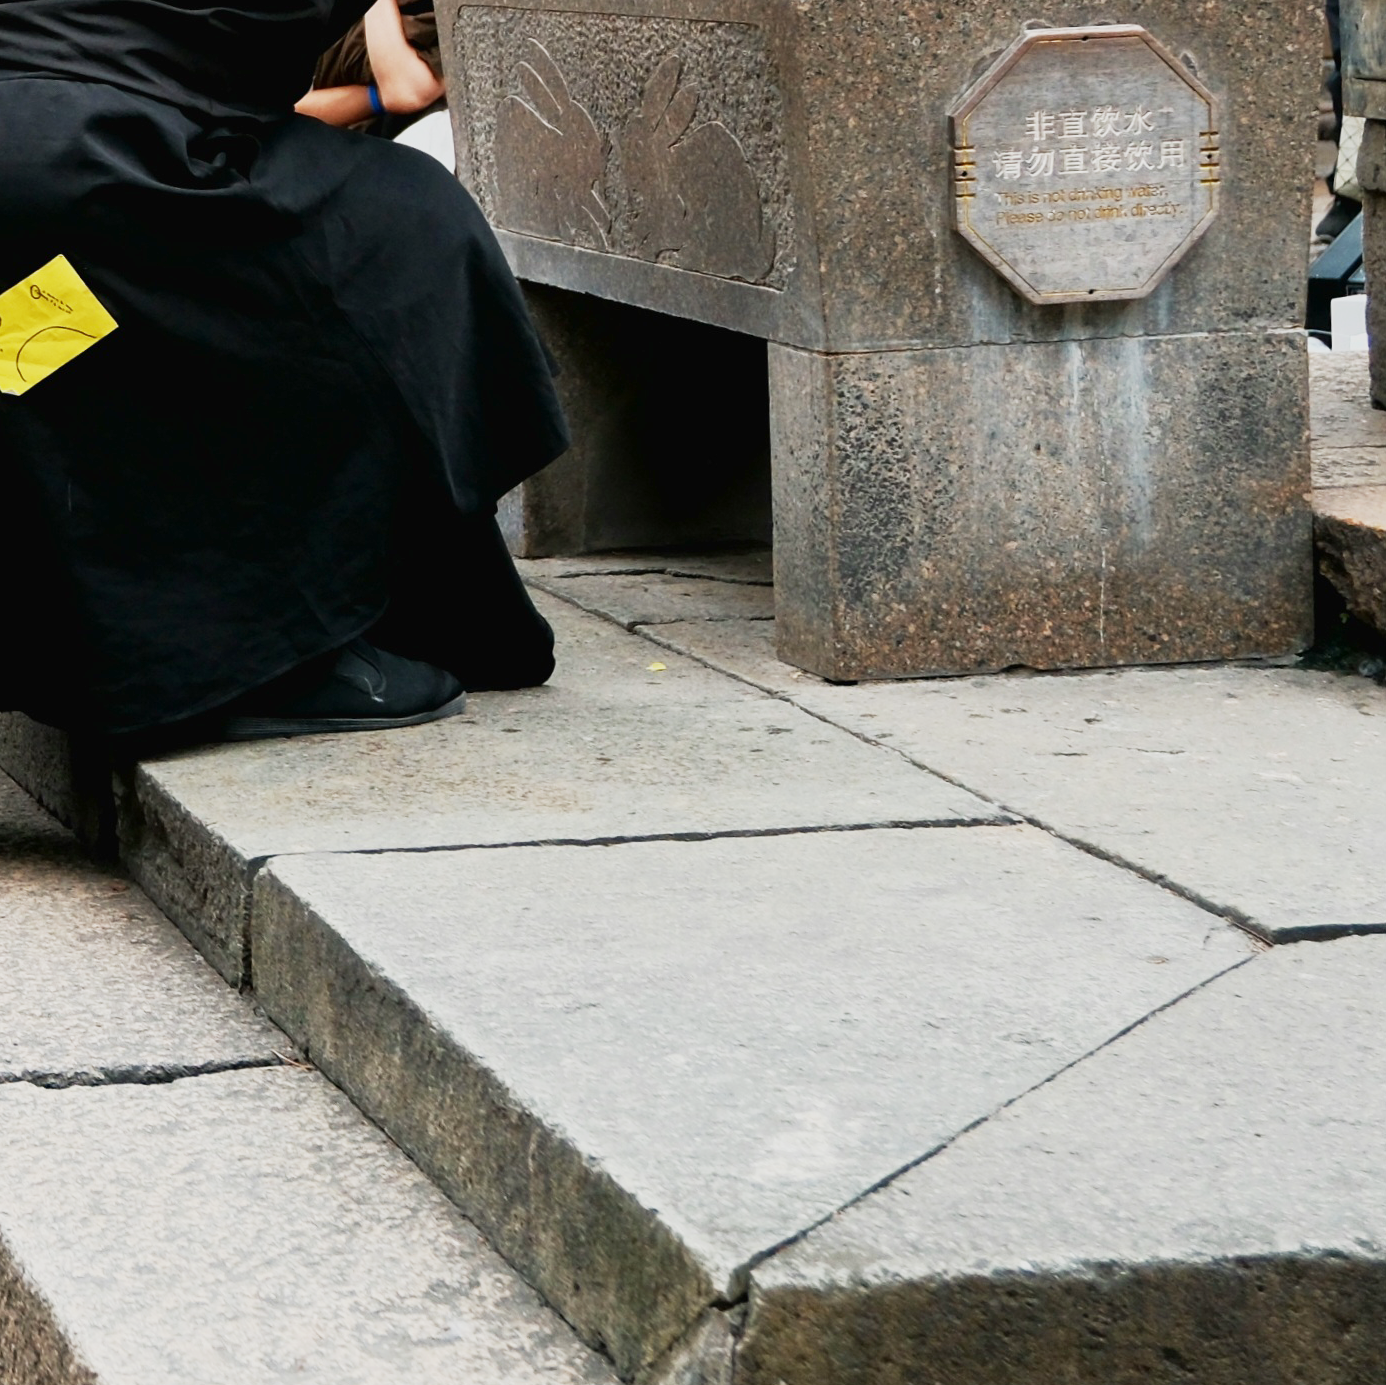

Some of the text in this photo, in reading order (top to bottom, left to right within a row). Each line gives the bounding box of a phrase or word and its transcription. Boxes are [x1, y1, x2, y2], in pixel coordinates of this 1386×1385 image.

[1025, 104, 1156, 141] 非直饮水
[992, 138, 1186, 180] 请勿直接饮用
[994, 190, 1025, 206] This
[1028, 191, 1040, 204] is
[1042, 190, 1066, 203] not
[1068, 185, 1123, 203] drinking
[996, 209, 1044, 226] Please
[1047, 208, 1063, 222] do
[1068, 207, 1090, 221] not
[1094, 204, 1128, 221] drink
